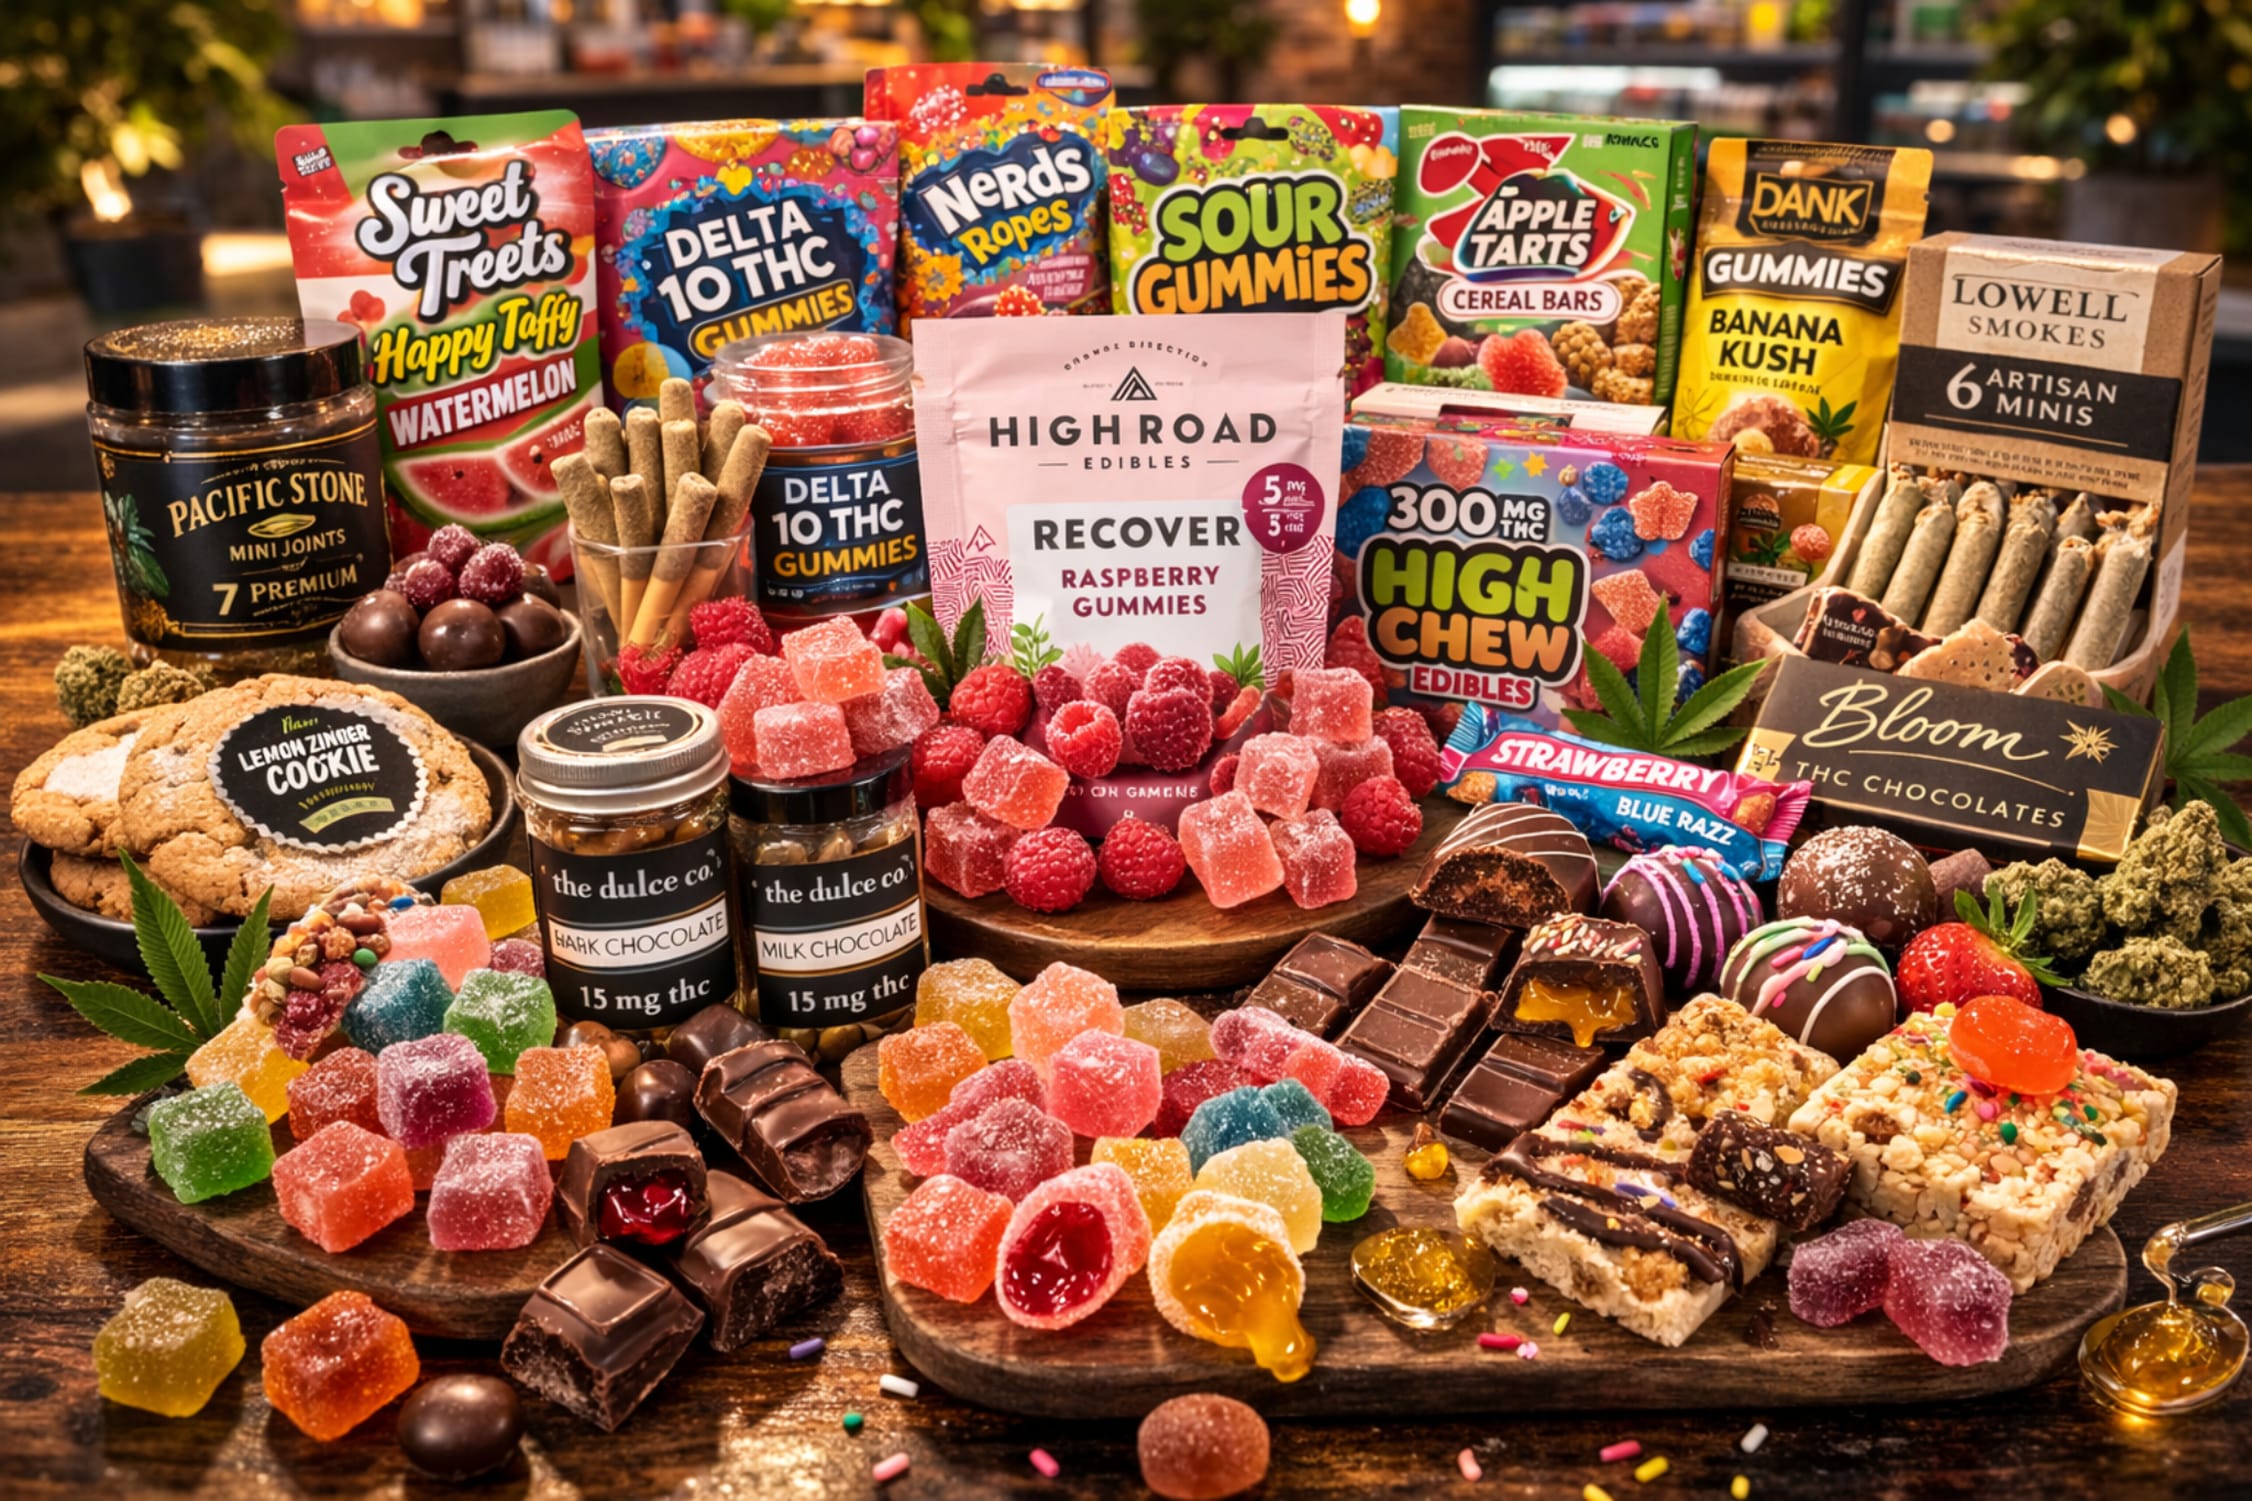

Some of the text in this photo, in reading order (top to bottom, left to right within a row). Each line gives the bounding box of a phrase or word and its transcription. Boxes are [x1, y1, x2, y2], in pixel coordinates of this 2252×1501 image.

[358, 160, 531, 251] Sweet
[1161, 180, 1343, 263] SOUR
[1476, 199, 1596, 230] APPLE
[1753, 181, 1866, 226] DANK
[665, 200, 813, 269] DELTA
[958, 199, 1073, 265] Ropes
[1470, 234, 1591, 267] TARTS
[396, 221, 566, 317] Treets
[657, 236, 836, 323] 10 THC
[1707, 253, 1888, 299] GUMMIES
[694, 283, 854, 357] GUMMIES
[1453, 290, 1602, 312] CEREAL BARS
[1952, 278, 2127, 323] LOWELL
[374, 293, 579, 384] Happy Taffy
[1709, 309, 1844, 346] BANANA
[1968, 316, 2107, 350] SMOKES
[1719, 340, 1818, 376] KUSH
[389, 357, 577, 447] WATERMELON
[1946, 362, 2119, 411] 6 ARTISAN
[990, 411, 1277, 447] HIGH ROAD
[1996, 395, 2094, 428] MINIS
[1084, 454, 1191, 470] EDIBLES
[166, 476, 284, 539] PACIFIC
[290, 470, 369, 508] STONE
[784, 469, 891, 505] DELTA
[772, 498, 904, 546] 10 THC
[1034, 515, 1241, 550] RECOVER
[1389, 485, 1546, 537] 300 MG
[1501, 519, 1546, 542] THC
[229, 528, 347, 562] MINI JOINTS
[773, 534, 918, 577] GUMMIES
[211, 563, 358, 616] 7 PREMIUM
[1061, 565, 1220, 589] RASPBERRY
[1371, 547, 1575, 624] HIGH
[1072, 595, 1207, 618] GUMMIES
[1376, 606, 1570, 673] CHEW
[1413, 667, 1532, 705] EDIBLES
[1802, 678, 2050, 761] Bloom
[237, 738, 306, 772] LEMON
[266, 744, 380, 796] COOKIE
[1490, 738, 1720, 793] STRAWBERRY
[1796, 760, 2066, 828] THC CHOCOLATES
[1616, 796, 1737, 846] BLUE RAZZ
[552, 869, 593, 899] the
[599, 868, 679, 900] dulce
[765, 880, 803, 904] the
[809, 872, 877, 903] dulce
[605, 911, 724, 957] CHOCOLATE
[762, 912, 917, 961] MILK CHOCOLATE
[579, 975, 711, 1016] 15 mg thc
[787, 972, 910, 1013] 15 mg thc
